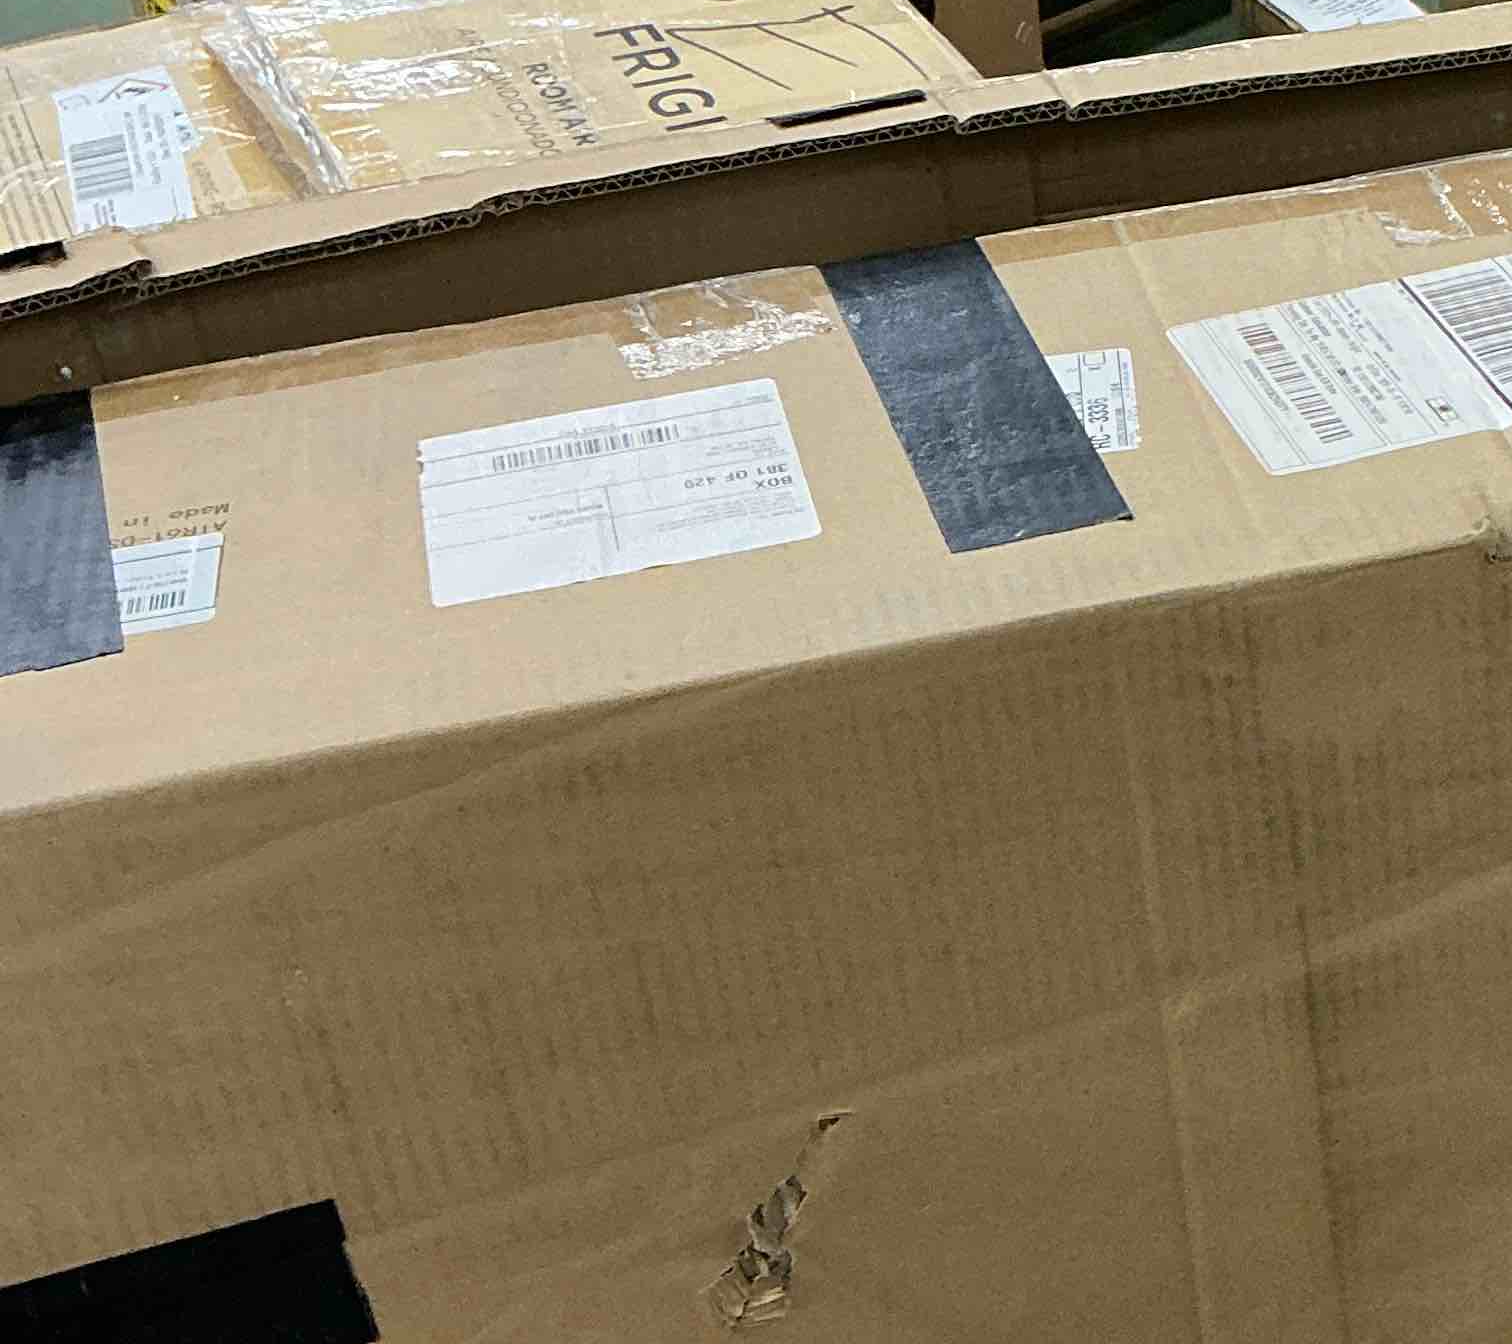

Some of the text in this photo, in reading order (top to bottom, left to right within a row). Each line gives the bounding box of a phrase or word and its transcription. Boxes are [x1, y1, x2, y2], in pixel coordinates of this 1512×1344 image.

[593, 23, 729, 132] FRIGI
[753, 474, 794, 492] BOX
[123, 502, 230, 527] Made in
